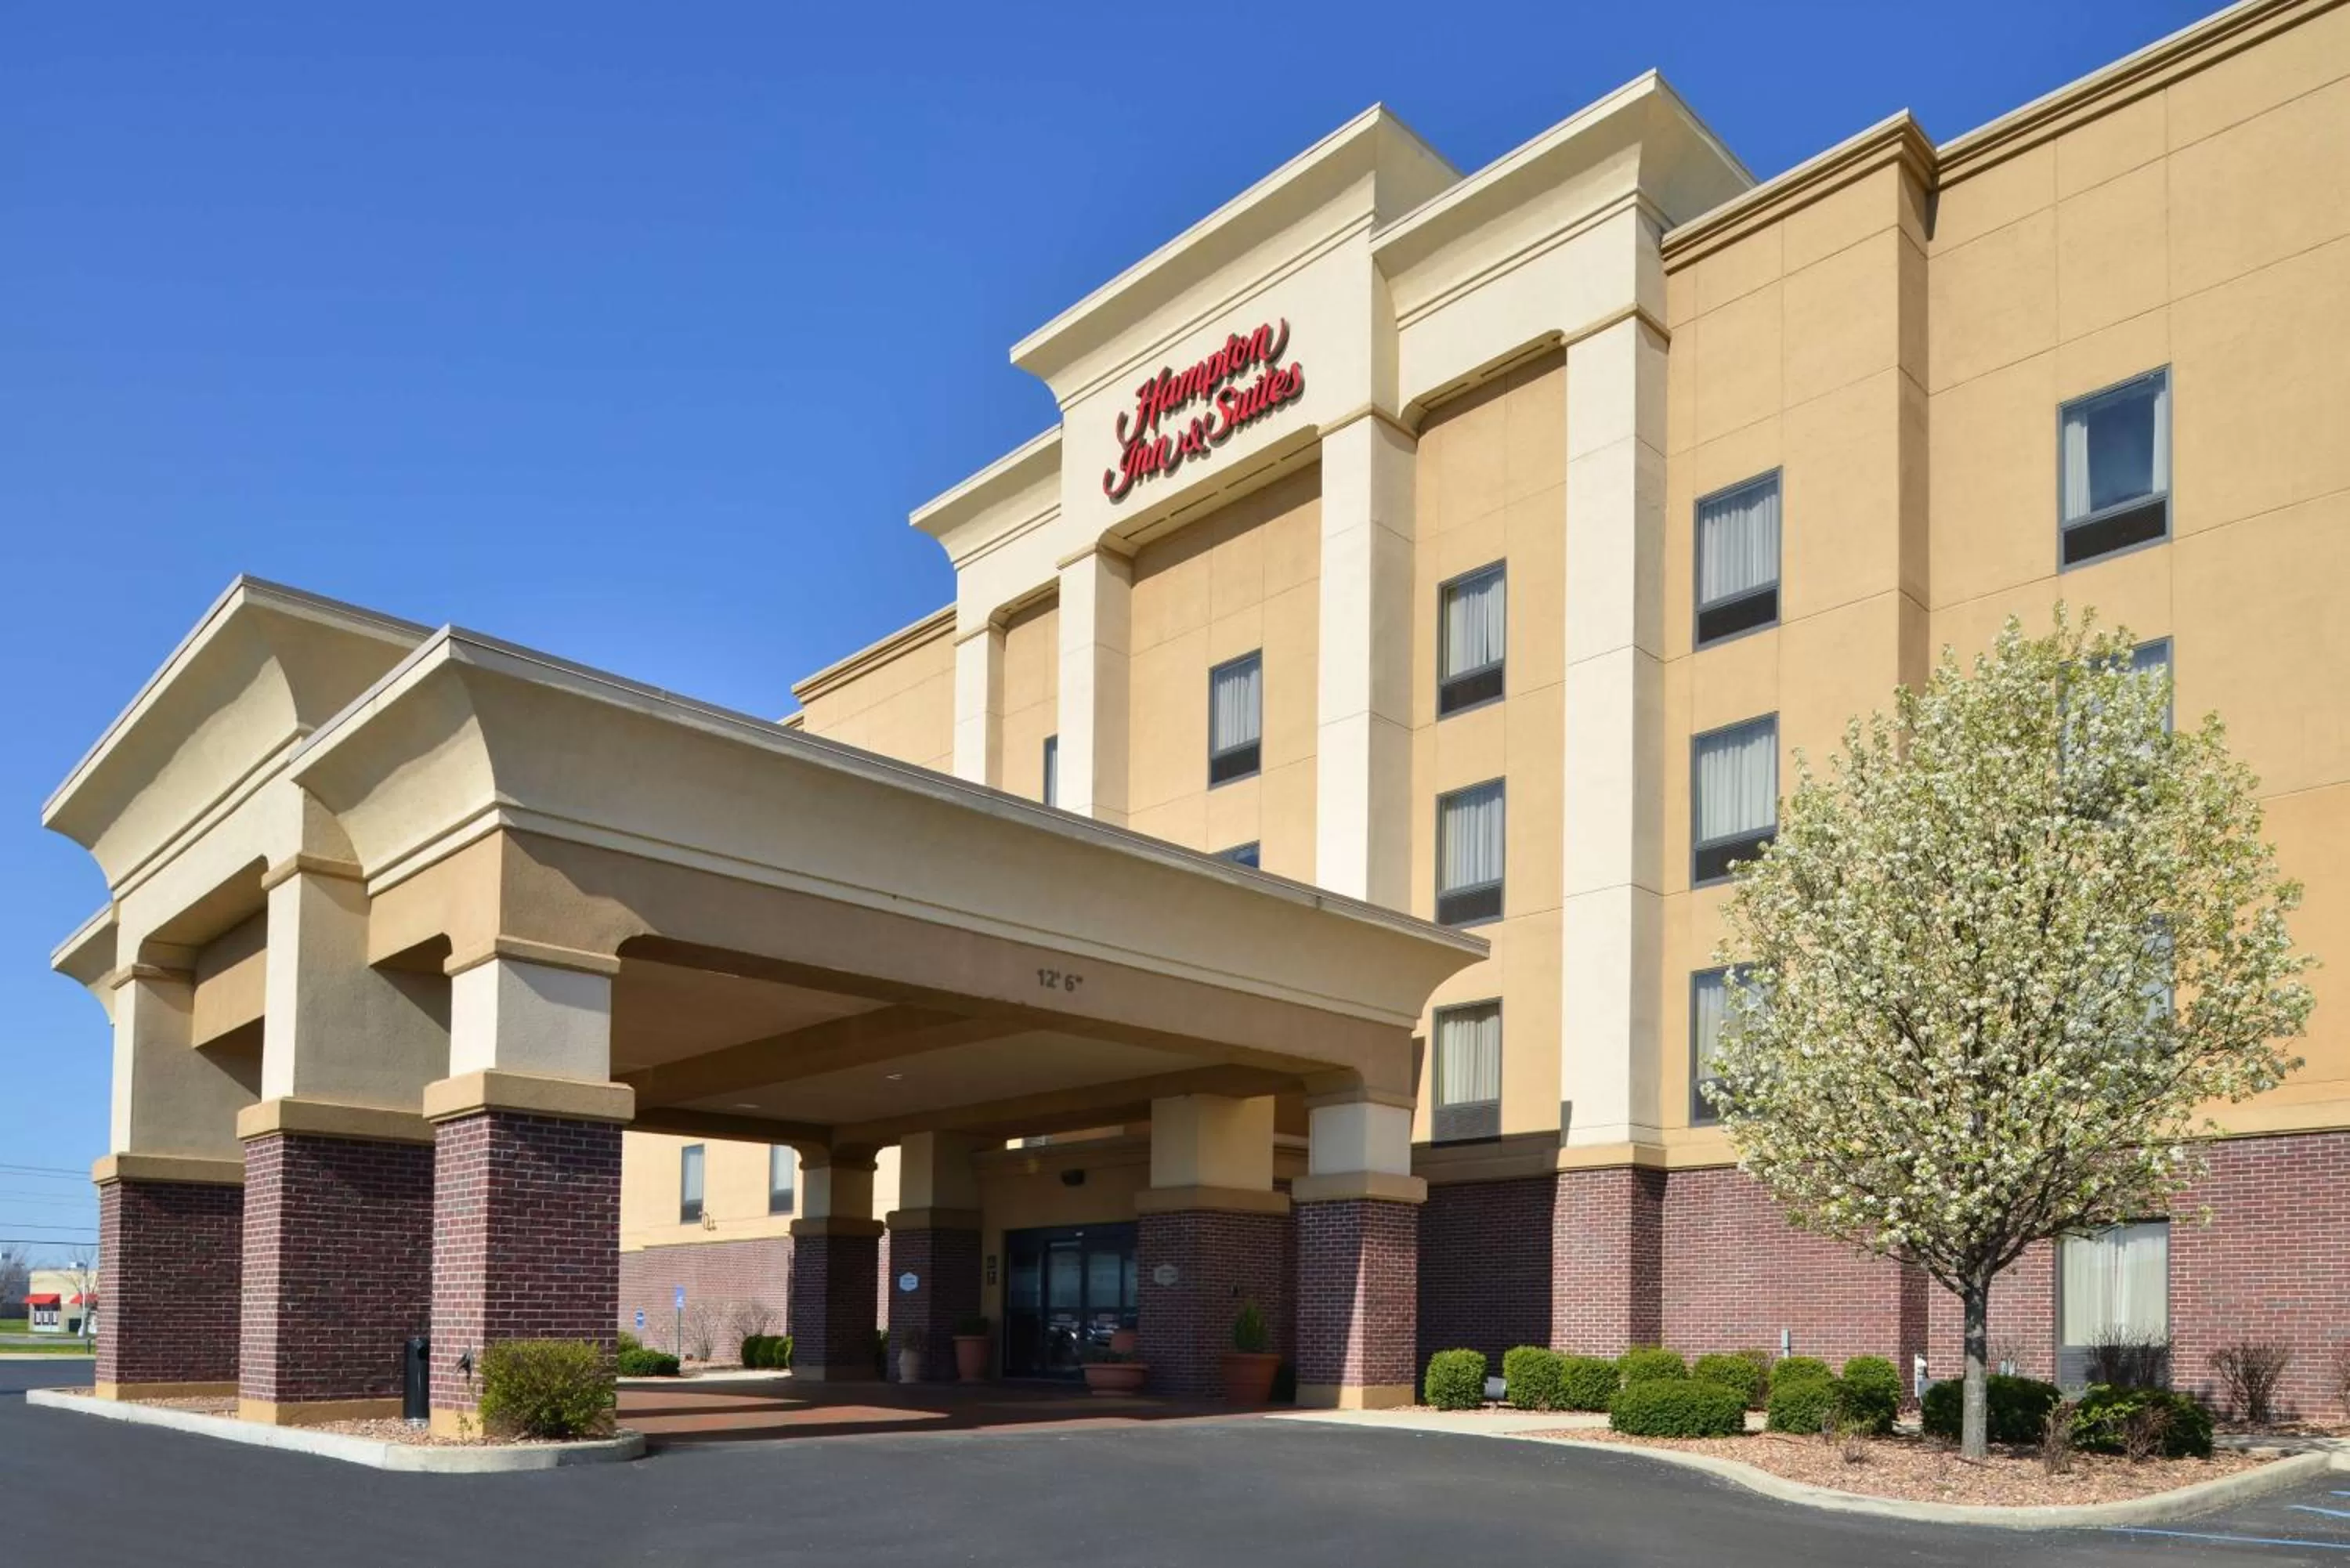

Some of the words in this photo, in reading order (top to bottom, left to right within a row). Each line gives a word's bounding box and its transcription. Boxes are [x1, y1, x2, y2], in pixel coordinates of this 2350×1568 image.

[1103, 430, 1184, 501] Inn
[1182, 417, 1209, 455] &
[1203, 361, 1304, 444] Suites
[1116, 317, 1289, 449] Hampton
